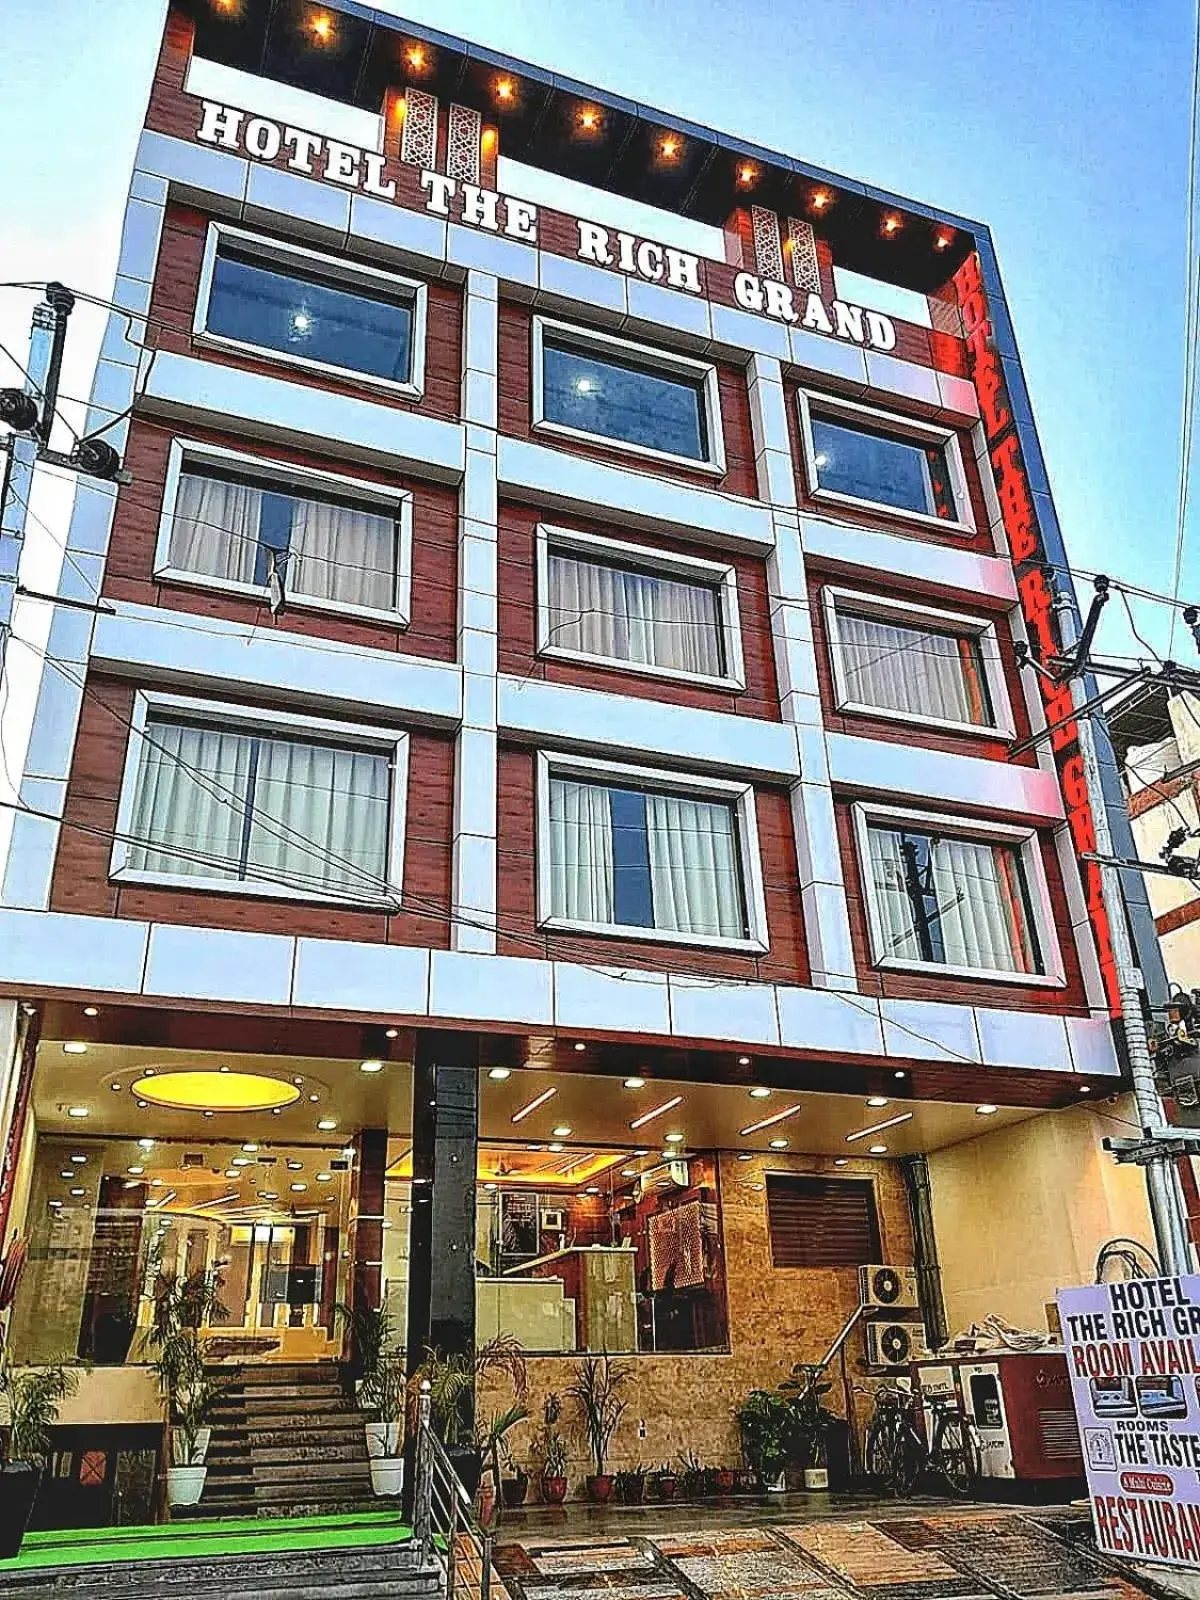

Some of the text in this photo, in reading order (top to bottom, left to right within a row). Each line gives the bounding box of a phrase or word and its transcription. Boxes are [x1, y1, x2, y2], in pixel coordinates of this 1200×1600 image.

[196, 99, 897, 351] HOTEL THE RICH GRAND
[1109, 1277, 1191, 1311] HOTEL
[1066, 1313, 1107, 1342] THE
[1111, 1309, 1168, 1340] RICH
[1071, 1338, 1200, 1378] ROOM AVAIL
[1117, 1420, 1169, 1432] ROOMS
[1114, 1433, 1200, 1468] THE TASTE
